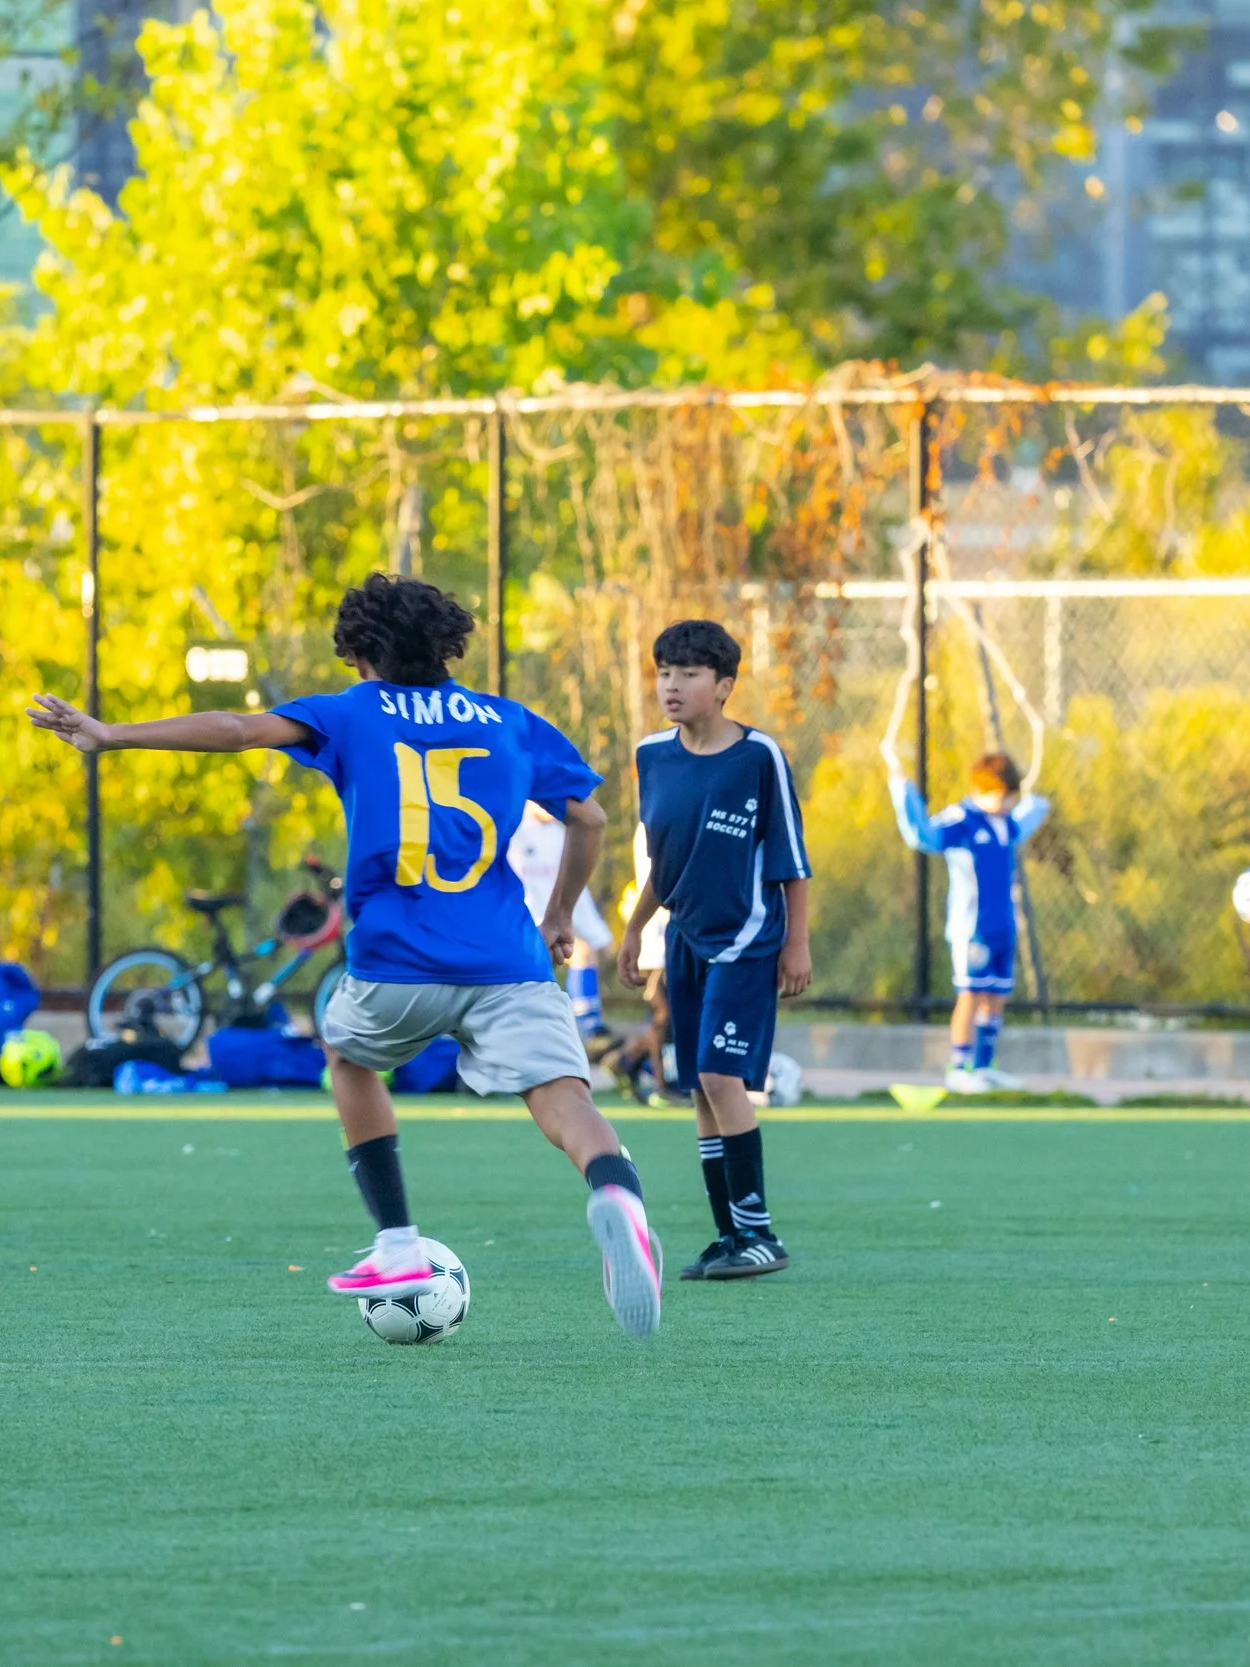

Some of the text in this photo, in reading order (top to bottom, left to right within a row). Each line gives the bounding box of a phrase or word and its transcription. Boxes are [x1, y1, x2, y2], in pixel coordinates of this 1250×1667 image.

[379, 690, 503, 724] SIMON
[394, 742, 497, 892] 15
[710, 809, 727, 820] MS
[706, 820, 747, 839] SOCCER
